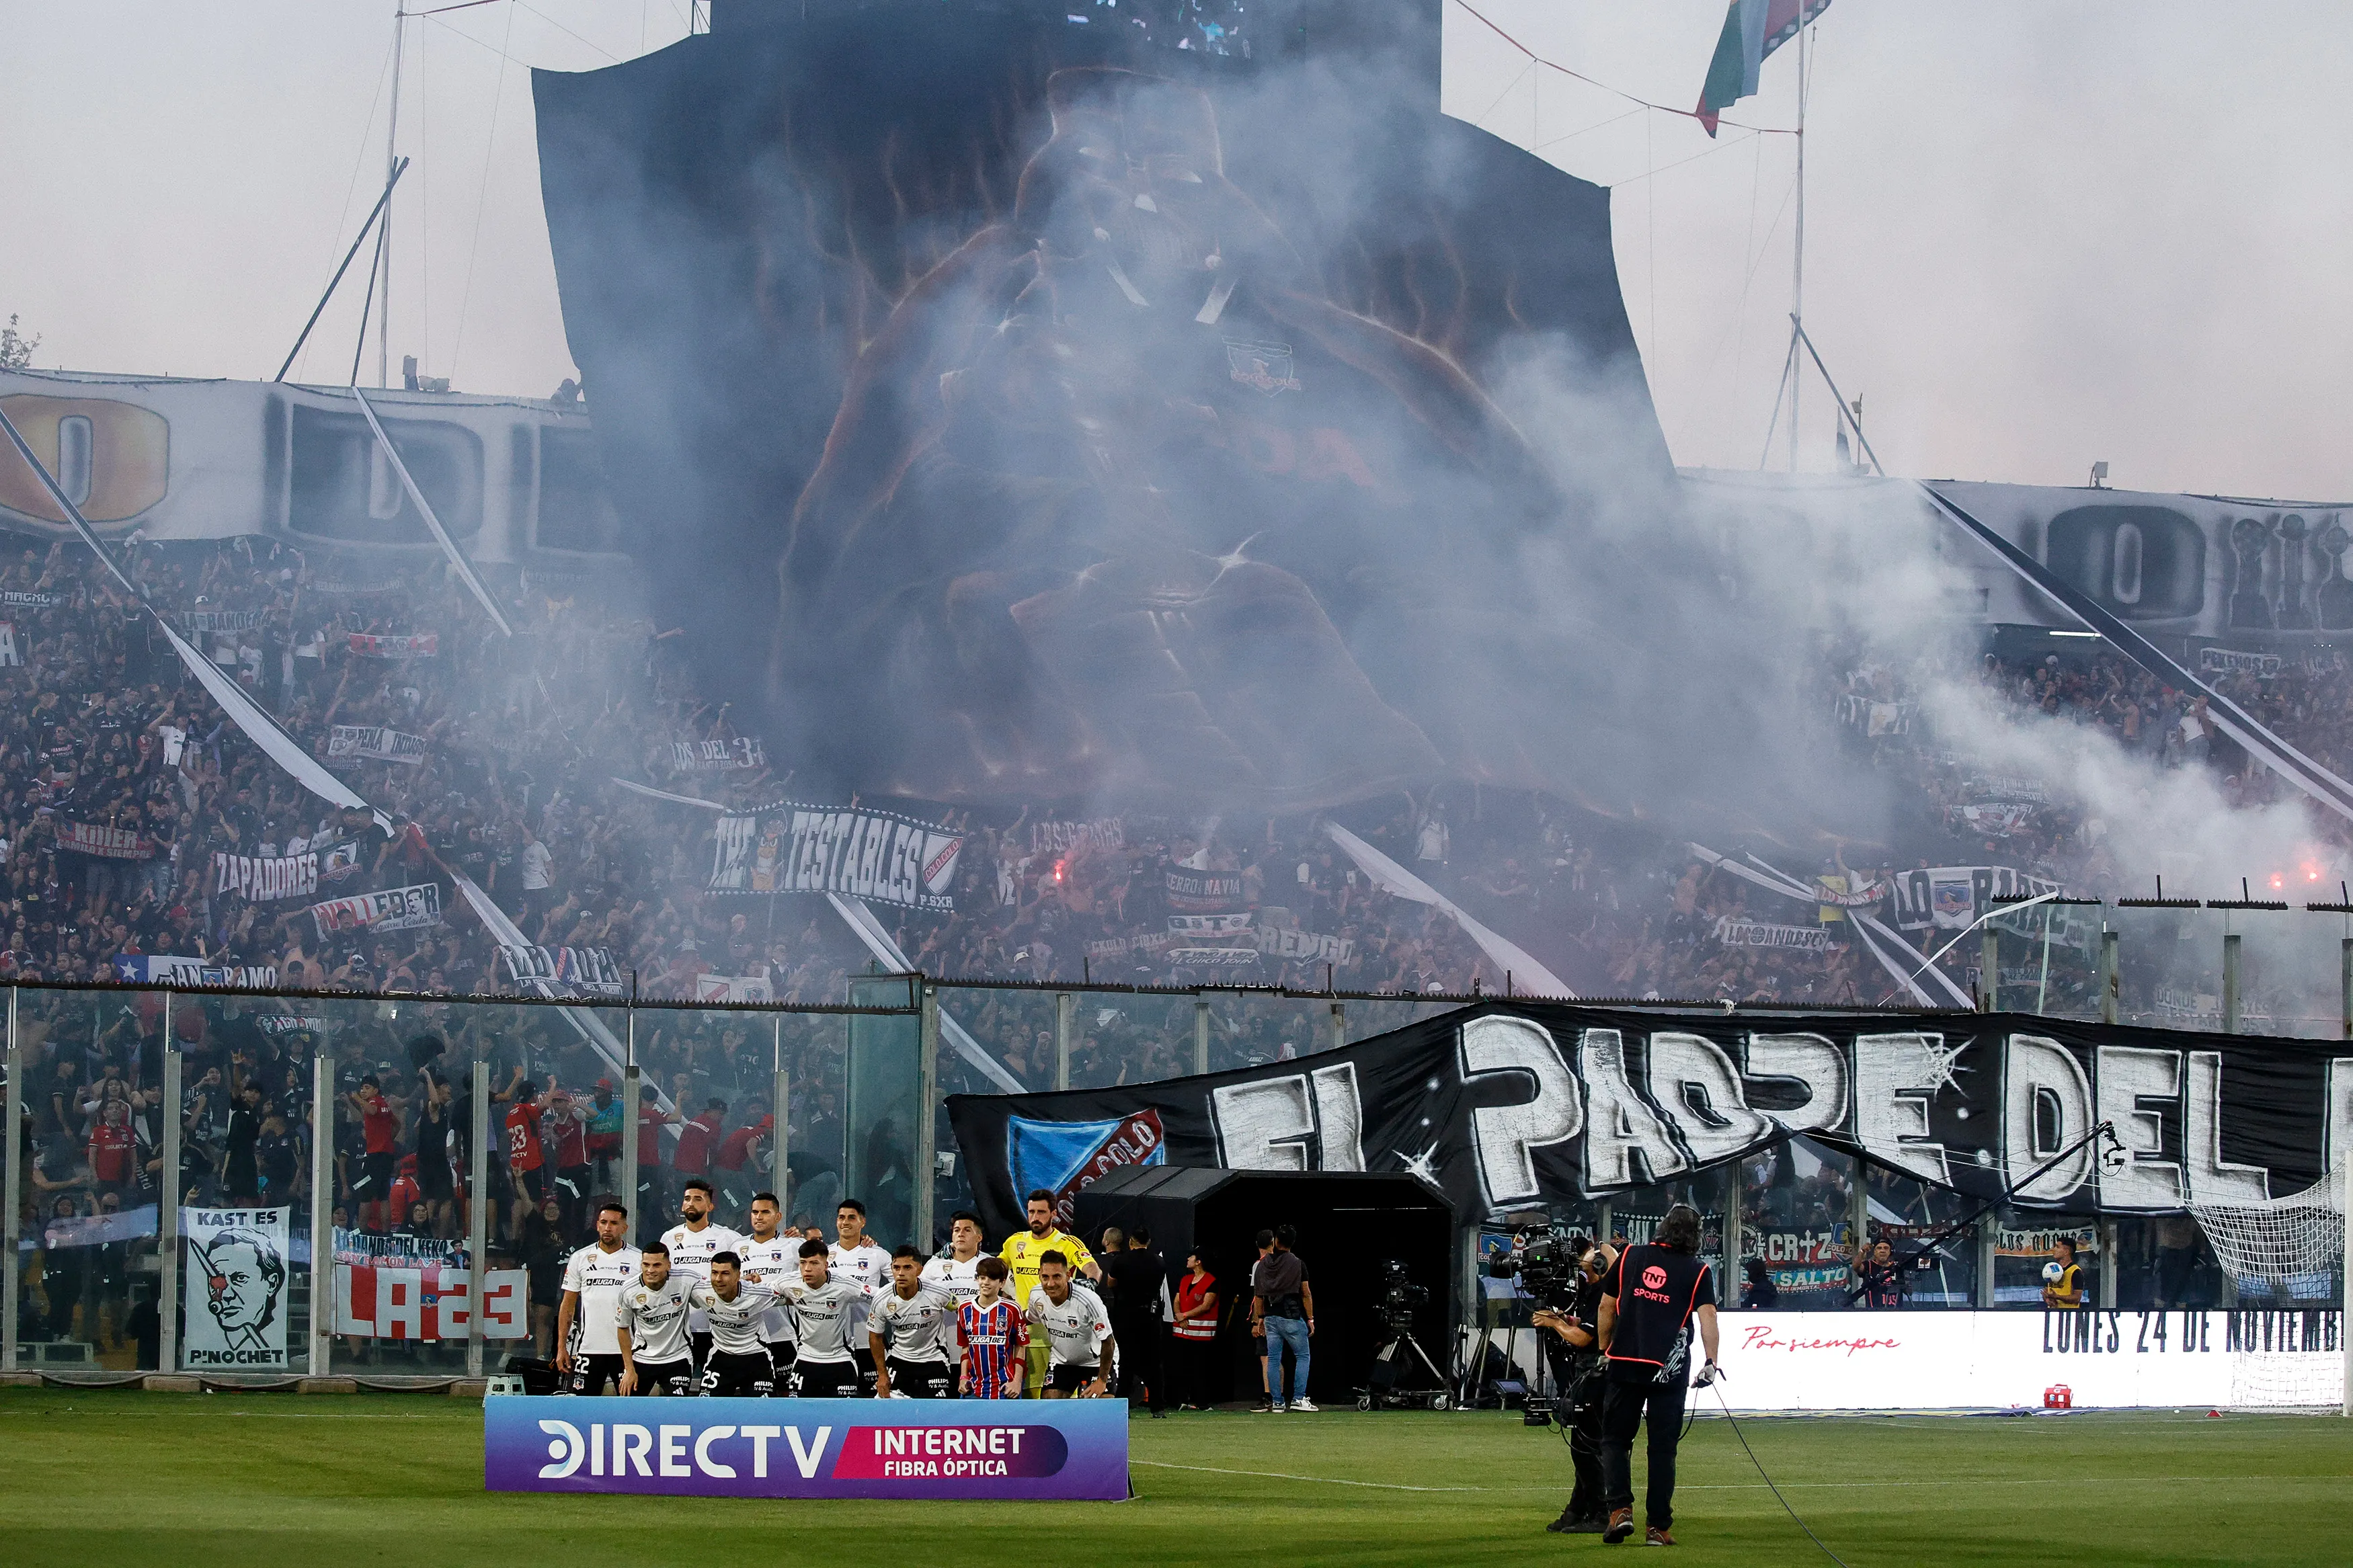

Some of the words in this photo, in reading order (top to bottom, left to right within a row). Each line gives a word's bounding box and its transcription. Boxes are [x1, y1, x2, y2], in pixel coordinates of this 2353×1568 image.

[700, 740, 729, 759] DEL
[785, 811, 924, 904] TESTABLES
[216, 852, 318, 901] ZAPADORES
[2005, 1033, 2271, 1210] DEL
[198, 1212, 247, 1226] KAST
[255, 1210, 278, 1225] ES
[1999, 1231, 2025, 1252] LOS
[748, 1268, 768, 1276] JUGA
[1642, 1270, 1667, 1284] TNT
[1780, 1266, 1847, 1287] SALTO
[592, 1278, 615, 1286] JUGA
[336, 1265, 422, 1338] LA
[1634, 1287, 1671, 1304] SPORTS
[649, 1313, 671, 1323] JUGA
[672, 1309, 684, 1319] BET
[715, 1320, 735, 1329] JUGA
[804, 1311, 824, 1320] JUGA
[920, 1320, 932, 1329] BET
[971, 1336, 991, 1344] JUGA
[991, 1336, 1006, 1344] BET
[1047, 1329, 1066, 1338] JUGA
[1742, 1326, 1787, 1350] Por
[1789, 1338, 1901, 1357] siempre
[2042, 1311, 2120, 1354] LUNES
[2136, 1311, 2167, 1354] 24
[2184, 1311, 2210, 1353] DE
[2227, 1311, 2344, 1353] NOVIEMB
[574, 1353, 590, 1374] 22
[701, 1370, 720, 1389] 25
[539, 1419, 832, 1479] DIRECTV
[875, 1428, 1026, 1456] INTERNET
[884, 1460, 939, 1477] FIBRA
[944, 1456, 1008, 1477] ÓPTICA
